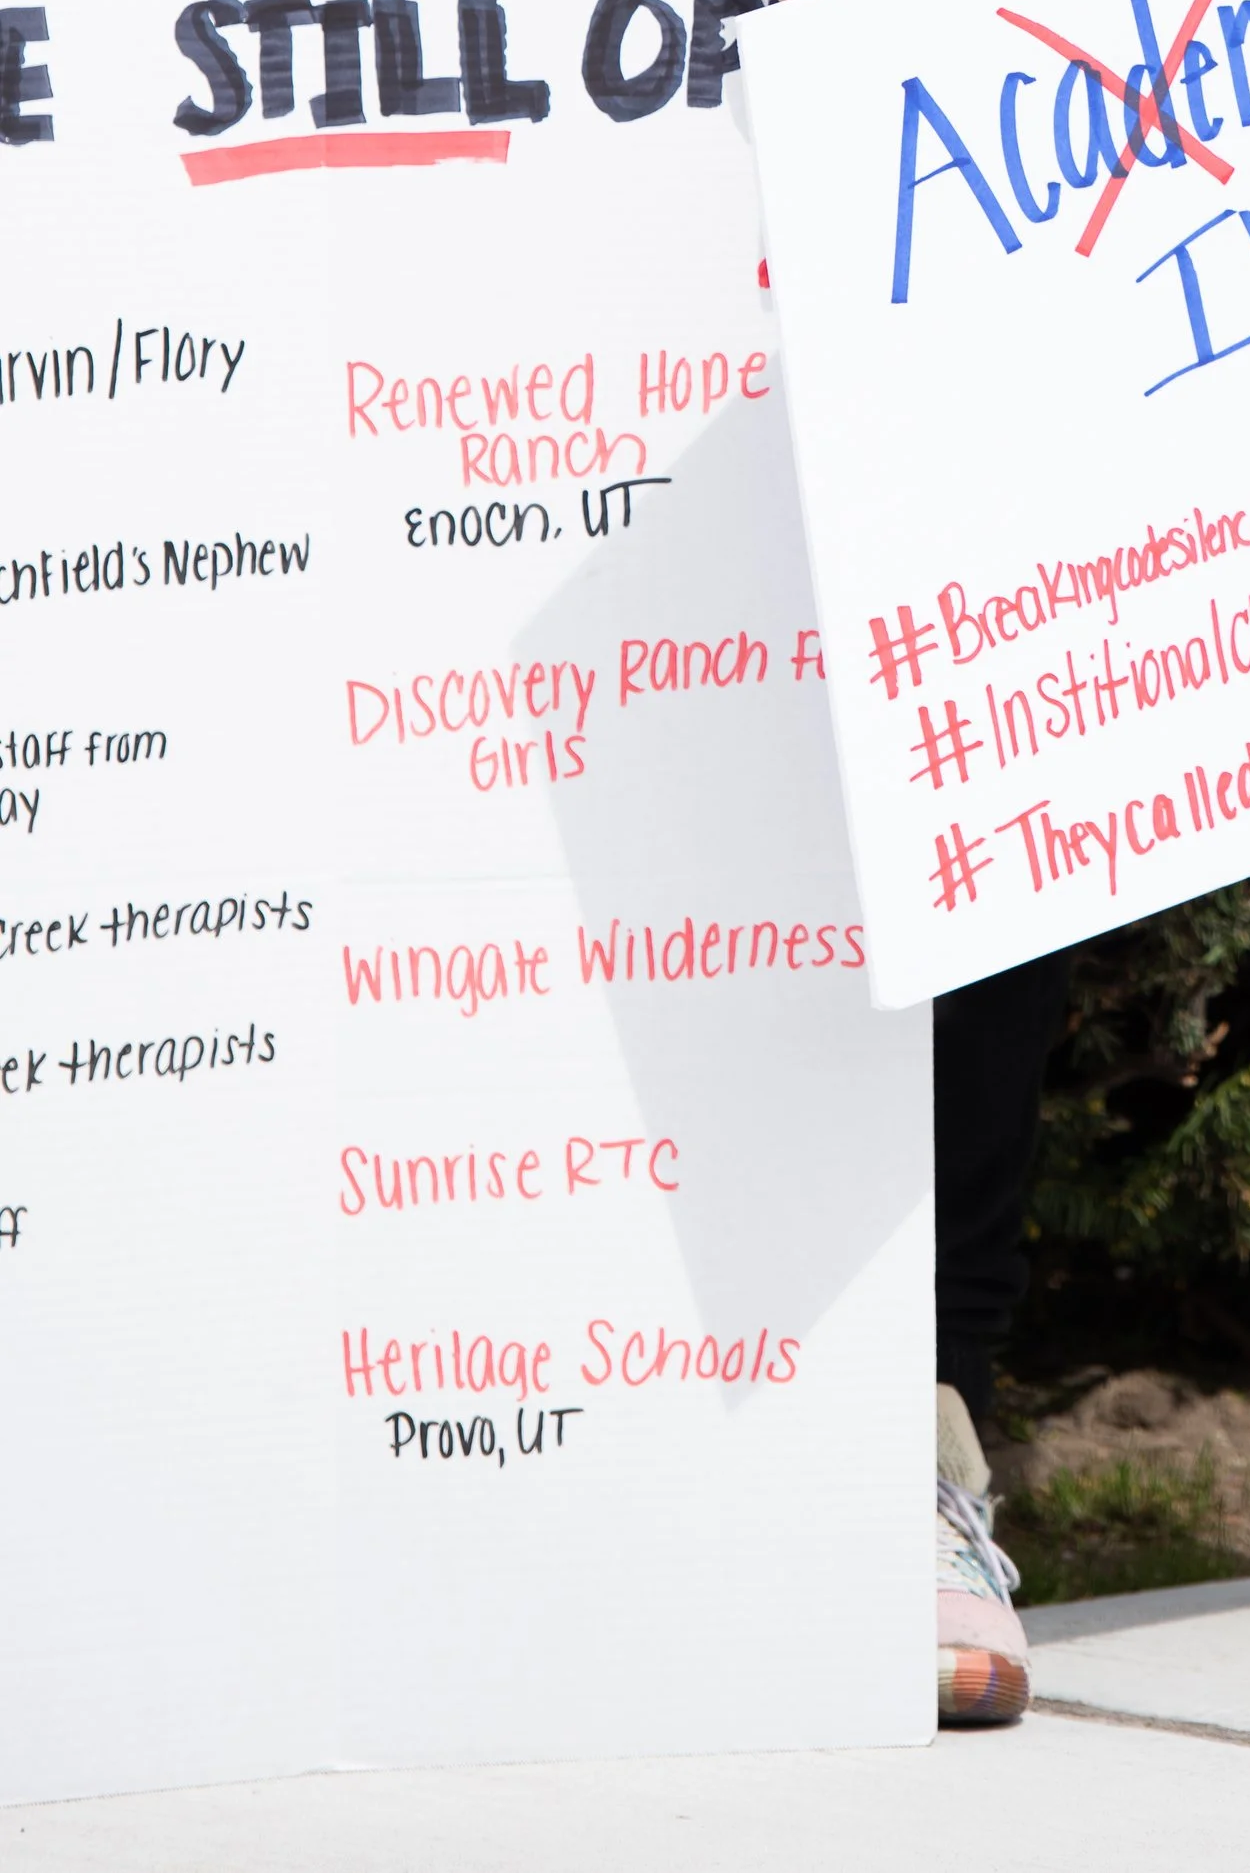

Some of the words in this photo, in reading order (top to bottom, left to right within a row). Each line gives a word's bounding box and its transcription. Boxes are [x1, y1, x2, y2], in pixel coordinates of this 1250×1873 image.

[346, 353, 595, 438] Renewed
[639, 350, 770, 416] Hope
[459, 427, 647, 487] Ranch
[582, 477, 672, 537] UT
[163, 532, 310, 590] Nephew
[346, 661, 596, 745] Discovery
[620, 630, 769, 708] Ranch
[85, 731, 167, 766] from
[469, 731, 587, 792] Girls
[100, 890, 313, 947] therapists
[343, 940, 550, 1017] Wingate
[577, 916, 867, 984] Wilderness
[58, 1023, 275, 1084] therapists
[339, 1145, 541, 1216] Sunrise
[565, 1136, 680, 1194] RTC
[580, 1319, 801, 1387] Schools
[385, 1411, 505, 1468] Provo,
[517, 1408, 584, 1455] UT
